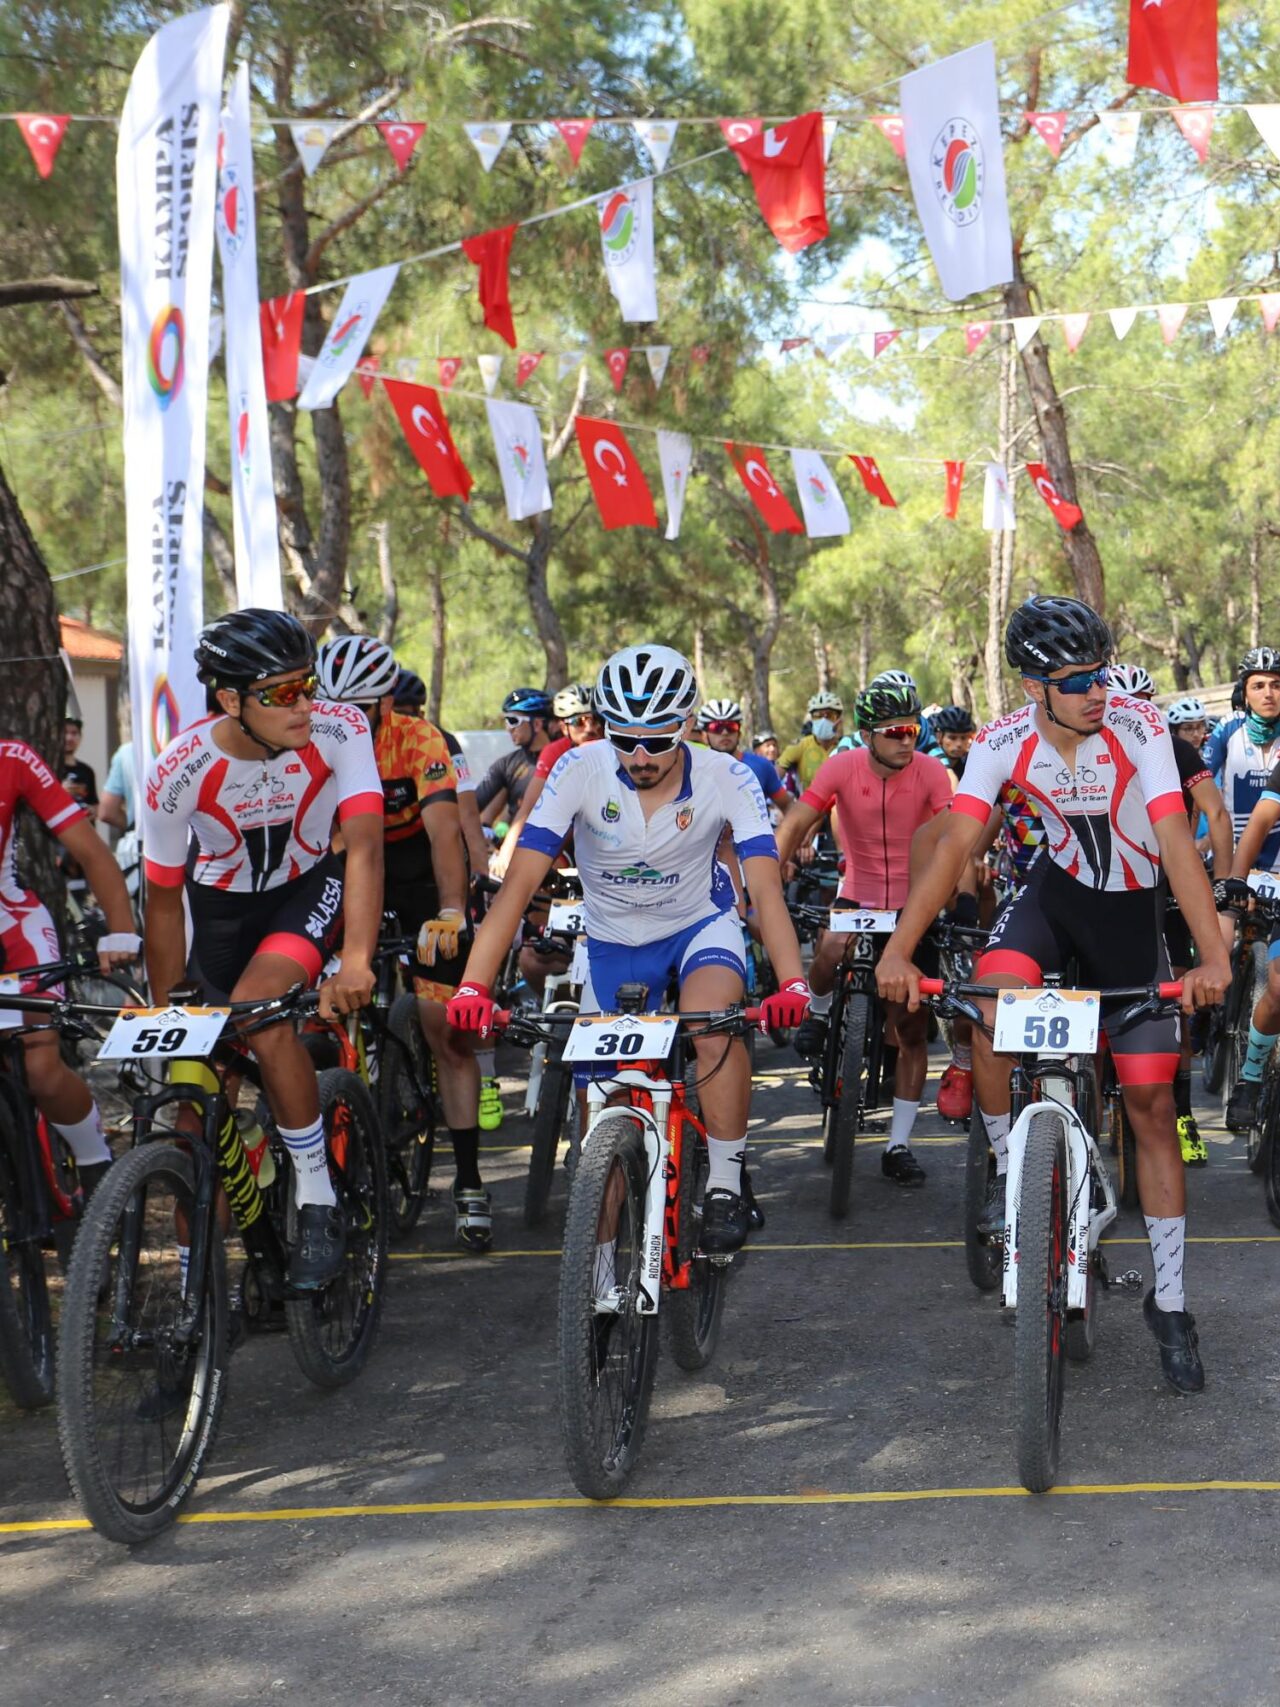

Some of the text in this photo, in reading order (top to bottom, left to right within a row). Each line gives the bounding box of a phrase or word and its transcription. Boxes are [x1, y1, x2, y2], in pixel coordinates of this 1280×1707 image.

[154, 116, 174, 280] KAMPA
[175, 102, 200, 279] SPORTS
[986, 706, 1031, 733] LASSA
[1108, 711, 1148, 746] Cycling Team
[1122, 697, 1165, 737] LASSA
[988, 730, 1014, 751] Cycling
[0, 742, 54, 789] rzurum
[154, 733, 203, 794] LASSA
[162, 751, 213, 815] Cycling Team
[316, 876, 344, 926] LASSA
[851, 918, 876, 930] 12
[131, 1027, 188, 1054] 59
[594, 1033, 645, 1056] 30
[1023, 1015, 1070, 1049] 58
[648, 1234, 662, 1280] ROCKSHOX
